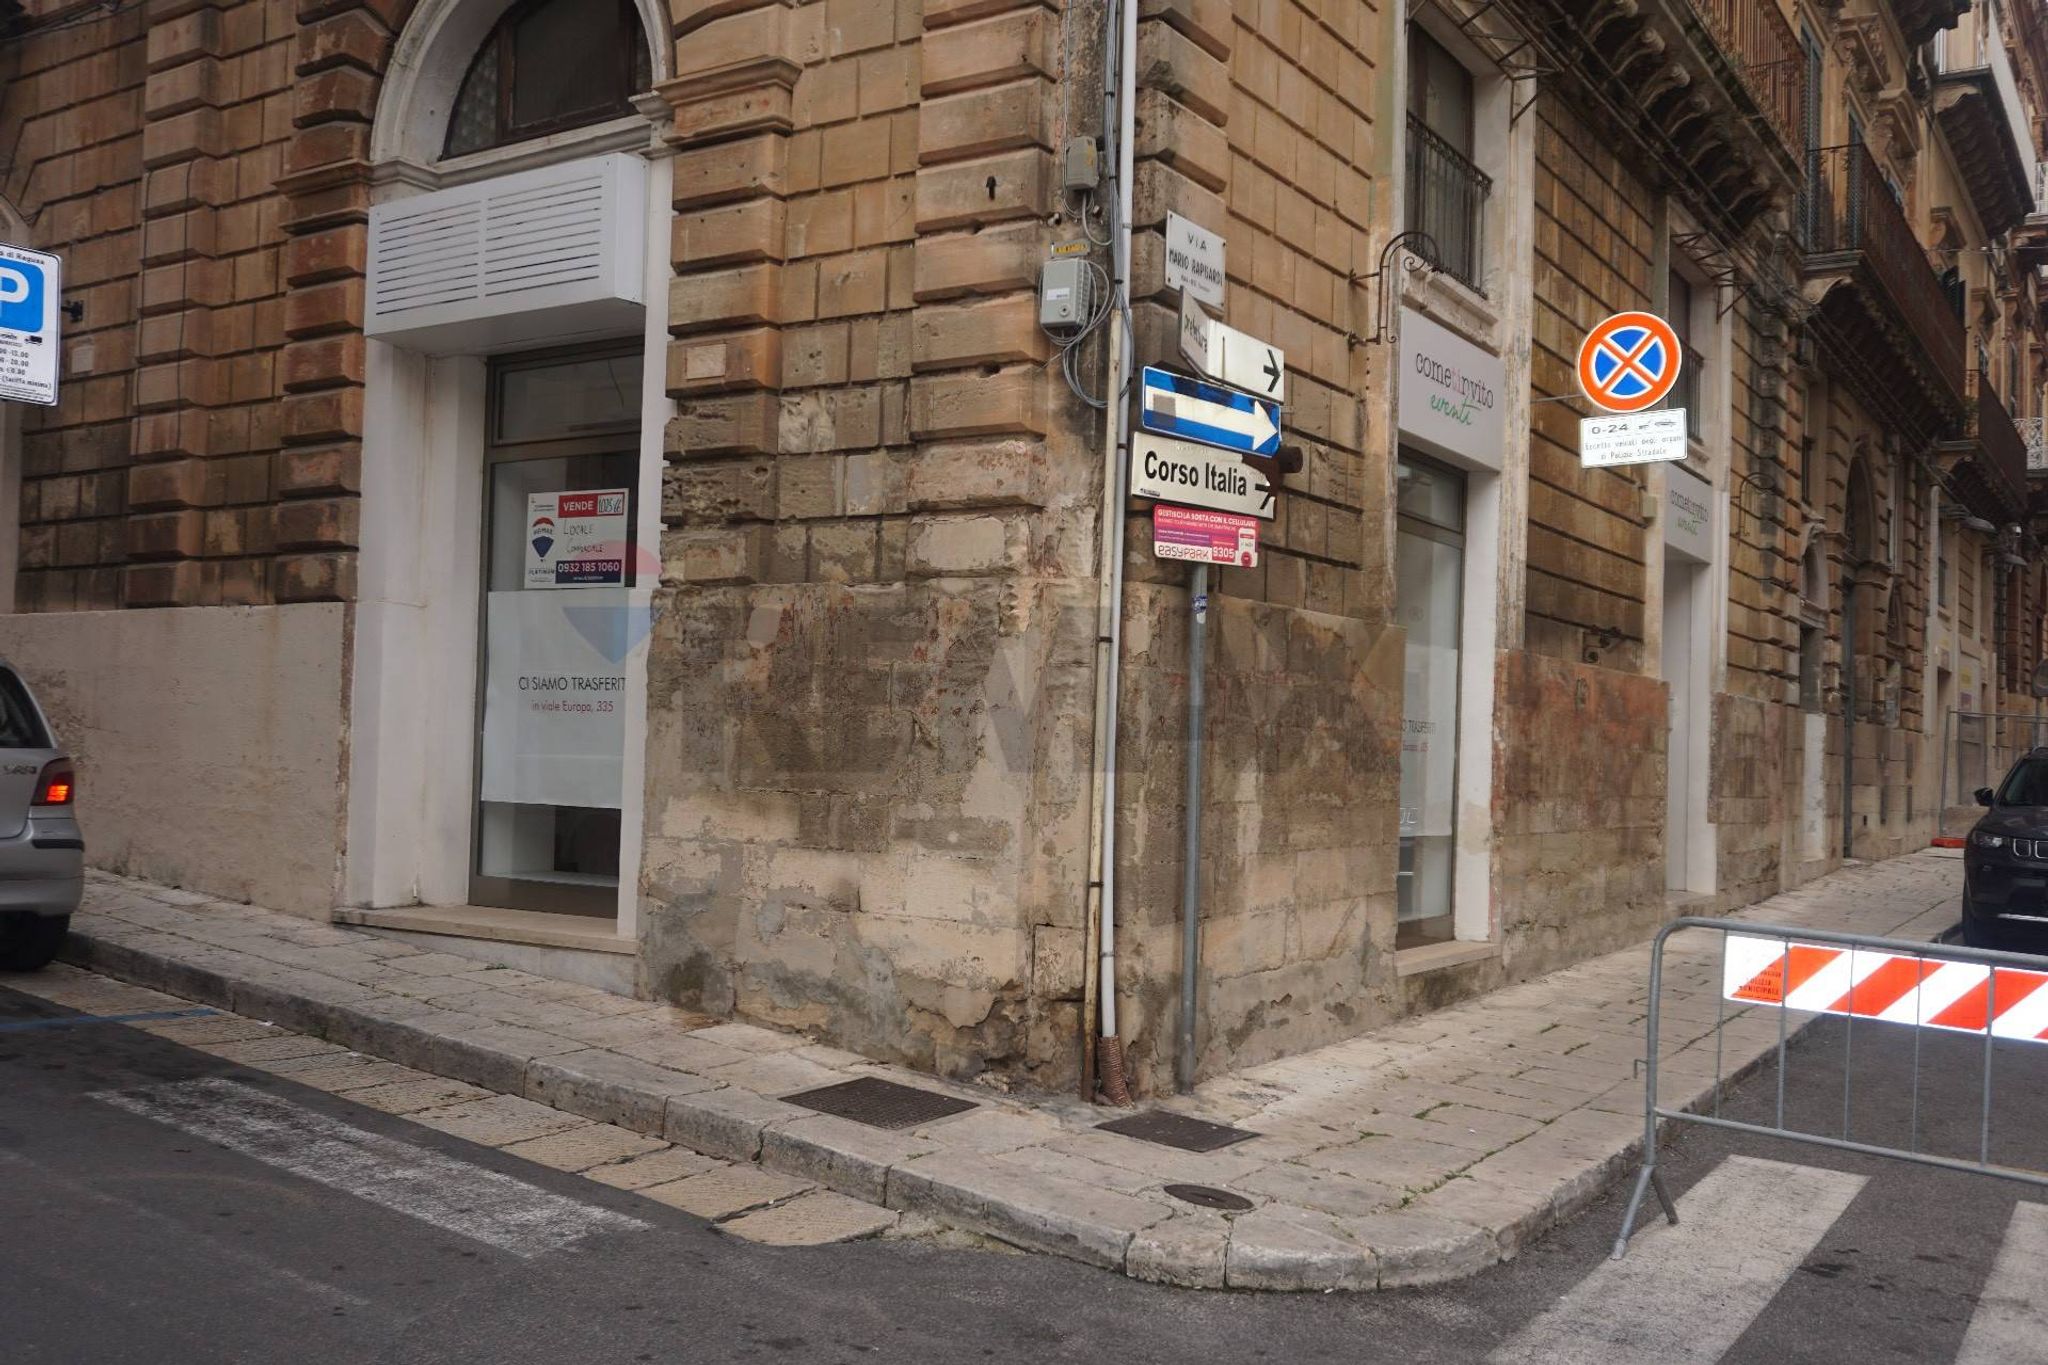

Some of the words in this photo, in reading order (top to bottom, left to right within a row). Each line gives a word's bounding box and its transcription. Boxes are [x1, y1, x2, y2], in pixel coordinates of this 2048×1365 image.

[1187, 232, 1207, 250] VIA
[1168, 249, 1190, 270] MARIO
[1144, 450, 1199, 487] Corso
[1205, 461, 1247, 497] Italia
[563, 501, 595, 512] VENDE
[1191, 512, 1209, 522] SOSTA
[1209, 515, 1223, 524] CON
[557, 562, 580, 573] 0932
[582, 562, 596, 572] 185
[598, 561, 620, 572] 1060
[518, 677, 530, 691] CI
[531, 677, 568, 691] SIAMO
[532, 700, 540, 711] in
[541, 700, 560, 712] viale
[562, 700, 594, 714] Europa,
[596, 700, 614, 712] 335
